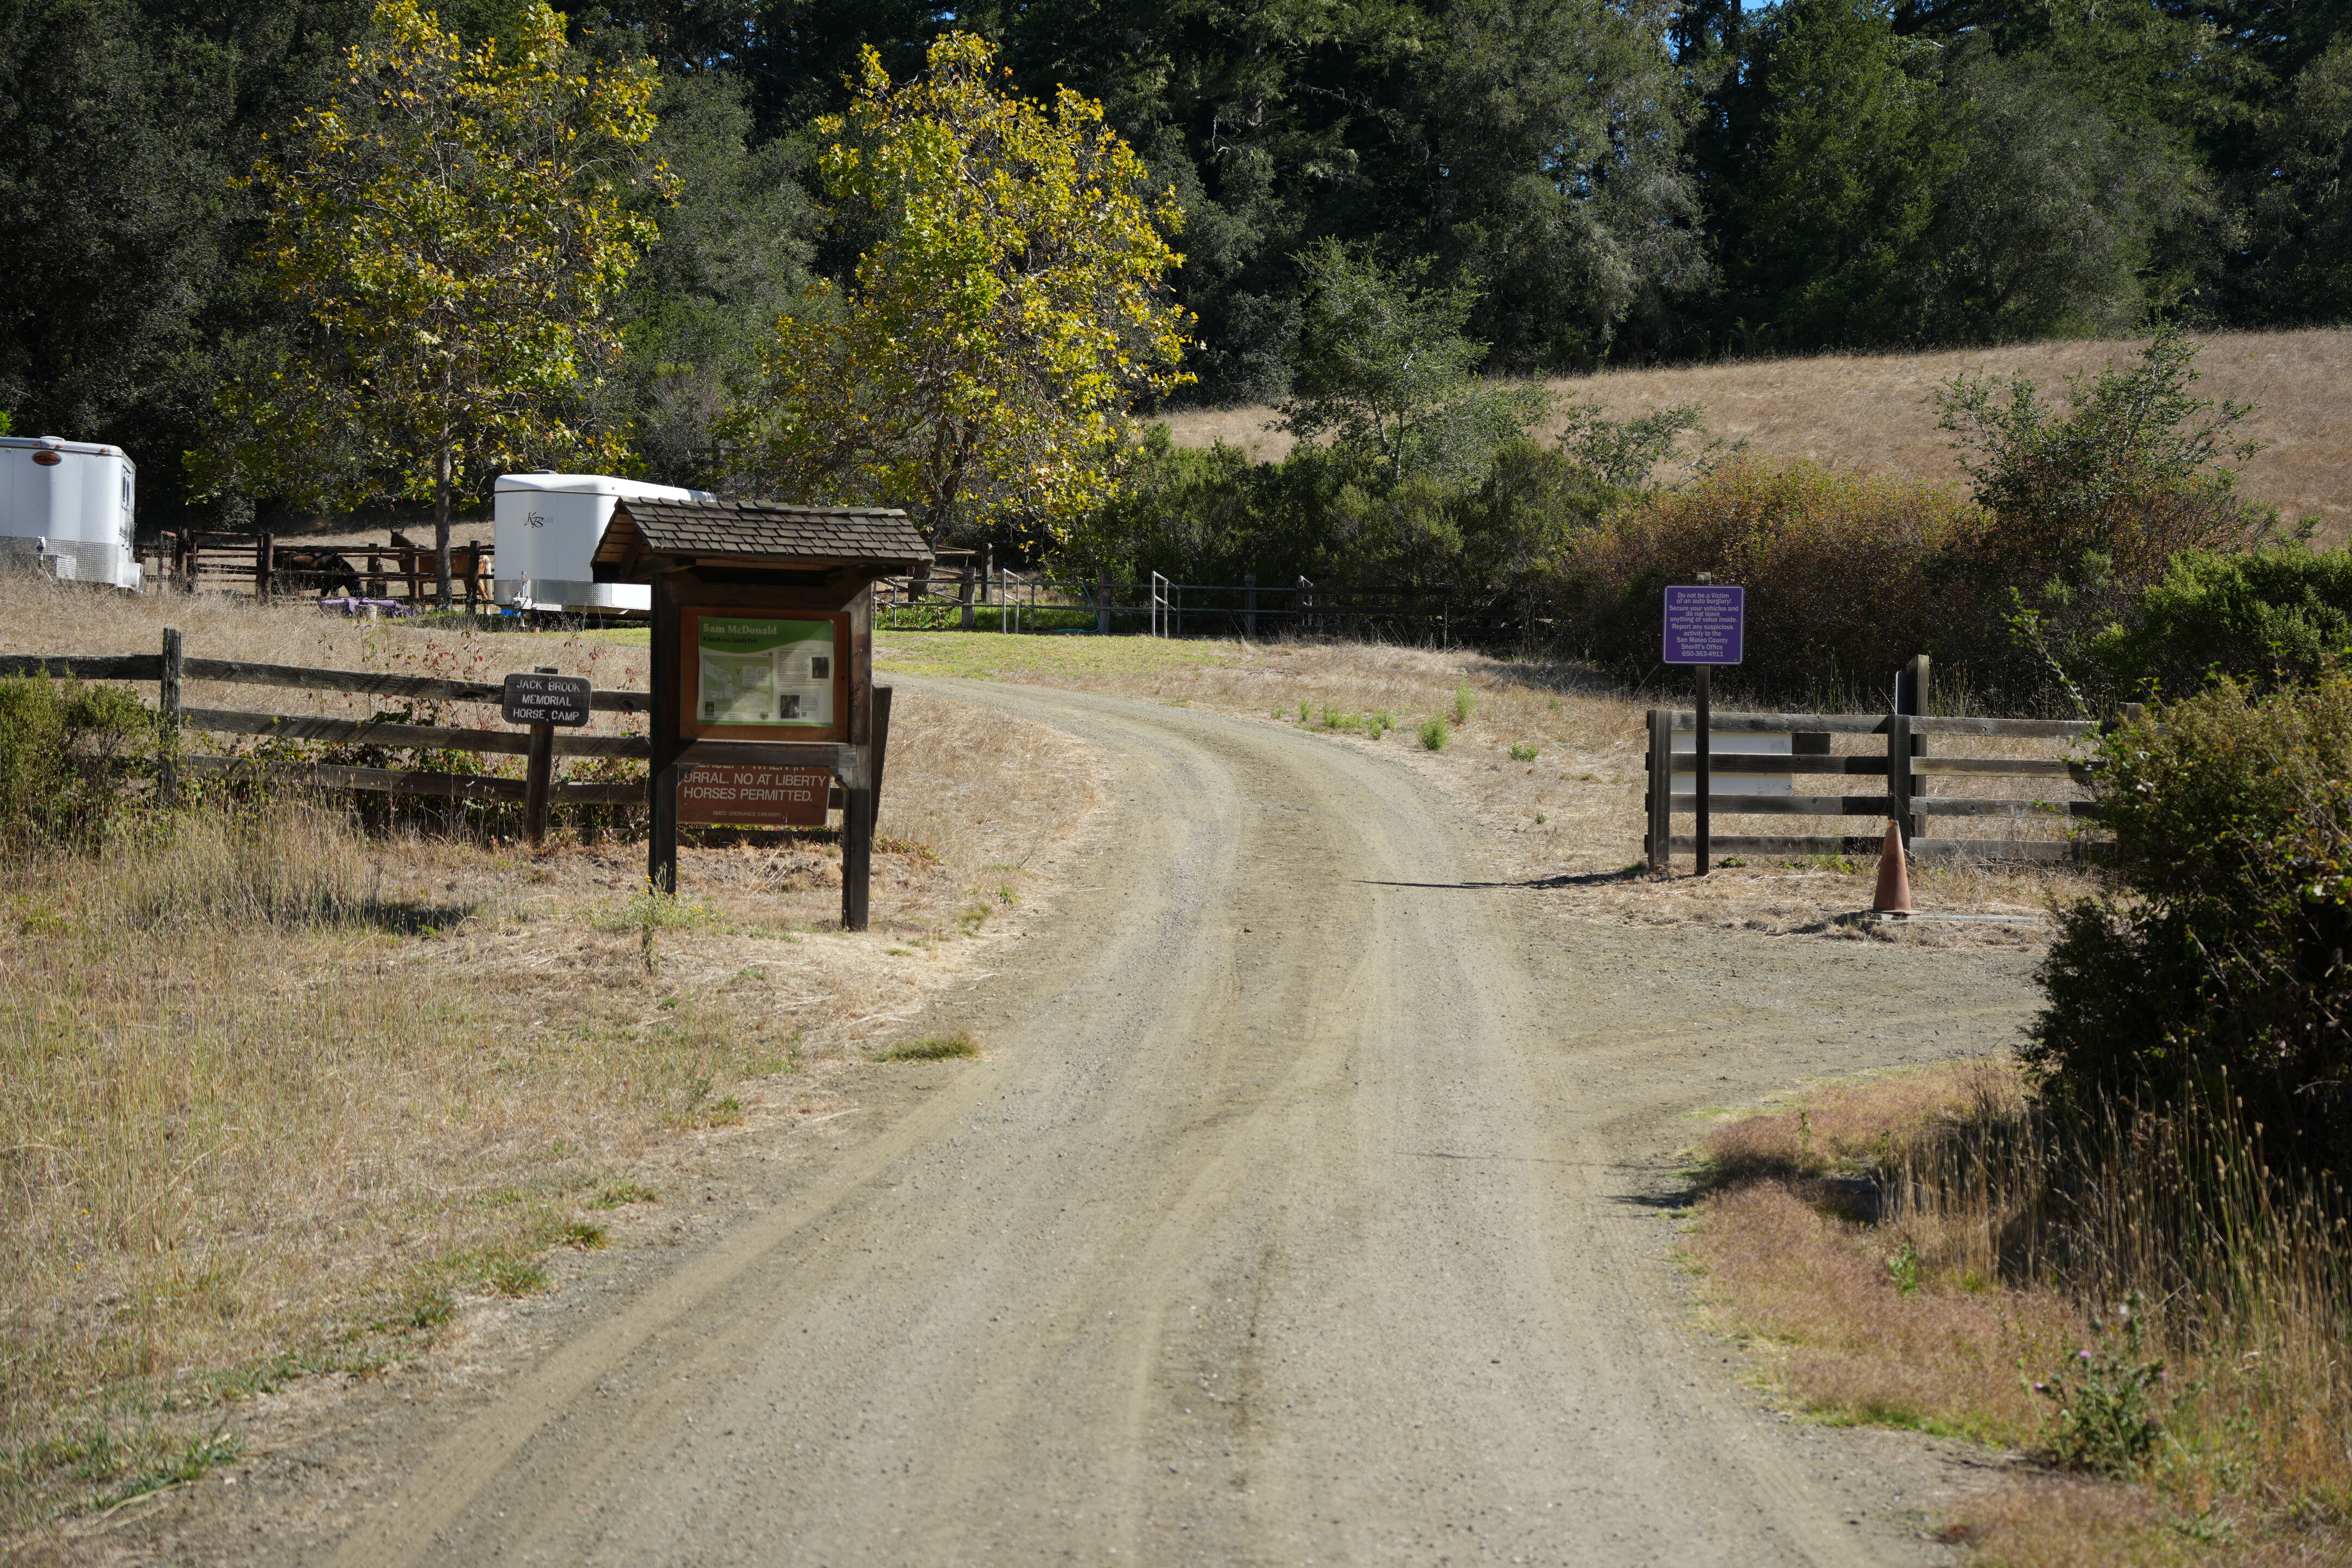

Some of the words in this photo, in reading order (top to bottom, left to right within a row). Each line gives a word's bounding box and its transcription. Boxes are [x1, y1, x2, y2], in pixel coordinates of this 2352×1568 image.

[703, 623, 725, 633] Sam
[727, 624, 777, 635] McDonald
[517, 679, 542, 690] JACK
[548, 681, 580, 692] BROOK
[522, 694, 572, 706] MEMORIAL
[513, 708, 546, 719] HORSE
[552, 710, 579, 721] CAMP
[684, 771, 729, 784] ORRAL.
[734, 773, 753, 785] NO
[757, 774, 772, 785] AT
[775, 774, 826, 787] LIBERTY
[684, 787, 736, 799] HORSES
[740, 790, 812, 801] PERMITTED.
